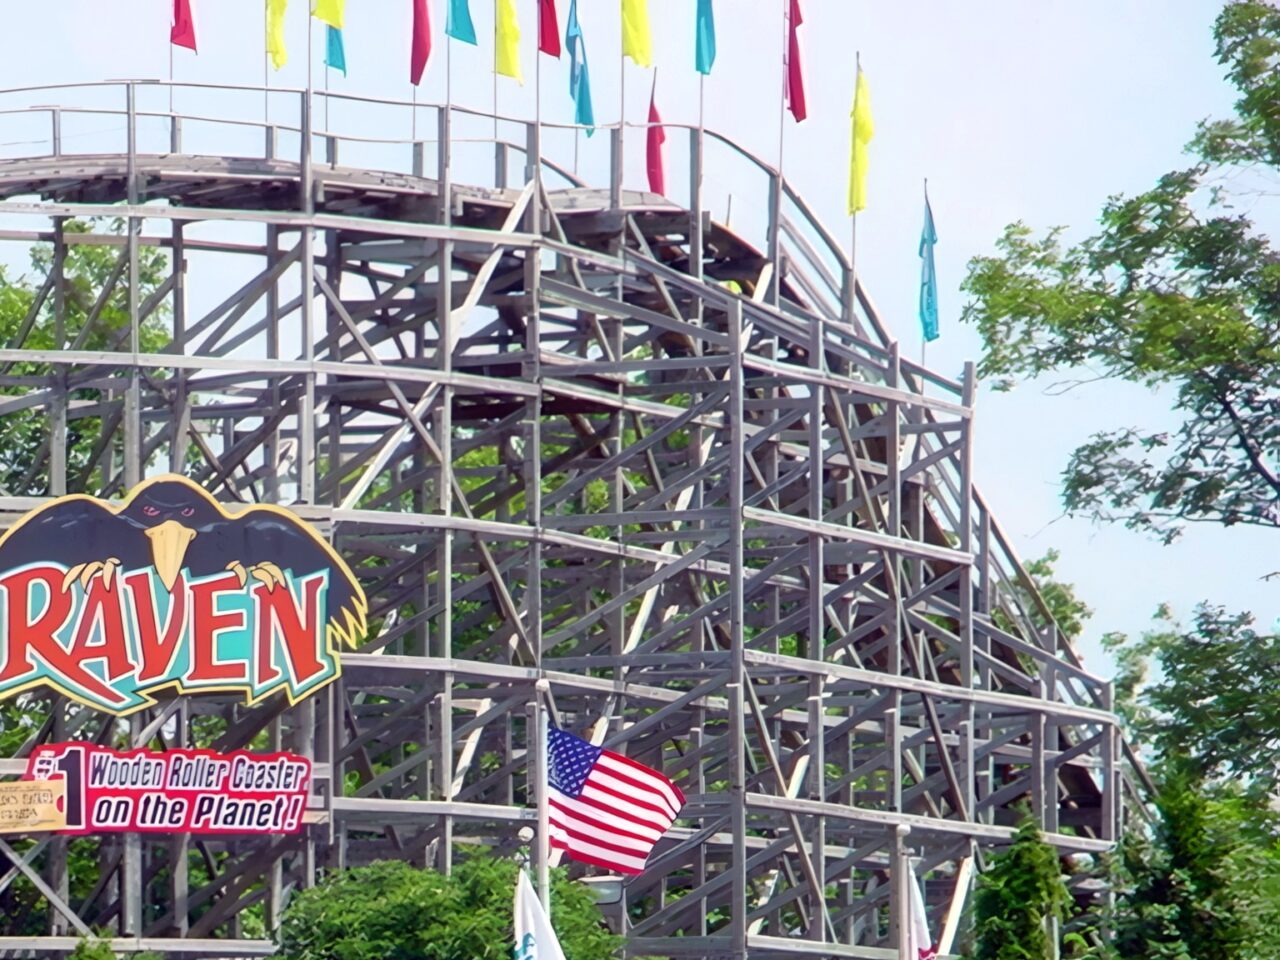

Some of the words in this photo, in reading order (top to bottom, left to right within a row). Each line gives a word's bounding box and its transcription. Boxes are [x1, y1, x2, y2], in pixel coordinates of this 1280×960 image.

[90, 753, 164, 787] Wooden
[169, 756, 228, 789] Roller
[232, 757, 306, 790] Coaster
[94, 799, 131, 826] on
[140, 795, 186, 826] the
[194, 796, 301, 828] Planet!
